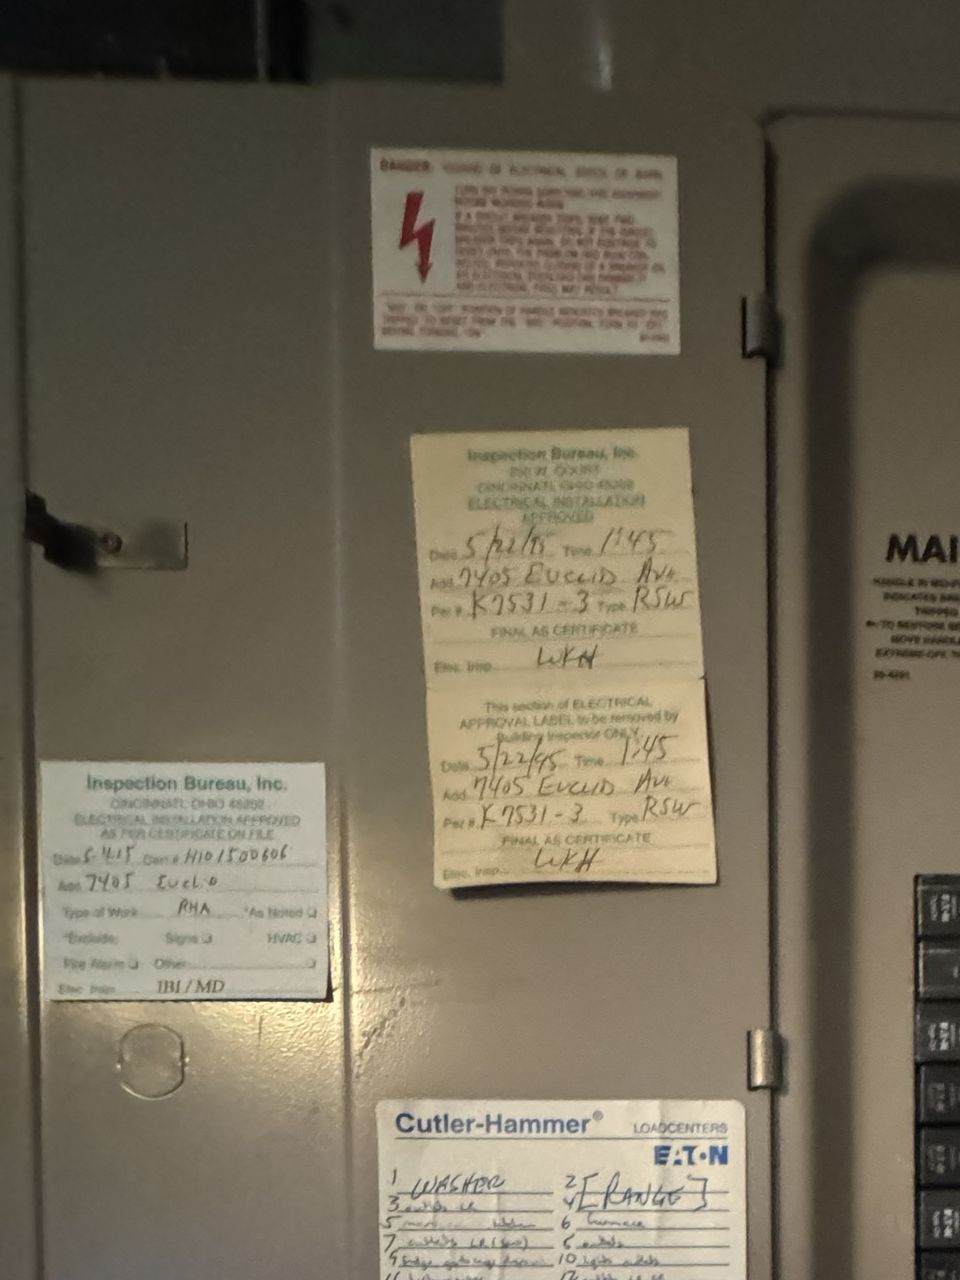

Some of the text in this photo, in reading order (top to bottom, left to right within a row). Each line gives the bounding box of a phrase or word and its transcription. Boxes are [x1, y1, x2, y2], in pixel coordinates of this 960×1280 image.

[467, 447, 546, 462] Inspection
[467, 495, 646, 511] ELECTRICAL INSTALLATION
[522, 512, 594, 524] APPROVED
[491, 622, 638, 638] FINAL AS CERTIFICATE
[573, 697, 653, 710] ELECTRICAL
[460, 715, 528, 731] APPROVAL
[533, 713, 575, 727] LABEL
[591, 713, 607, 725] be
[87, 773, 287, 794] Inspection Bureau, Inc.
[234, 814, 300, 826] APPROVED
[502, 831, 652, 847] FINAL AS CERTIFICATE
[633, 1121, 729, 1135] LOADCENTERS
[653, 1145, 729, 1165] EATON
[411, 1173, 505, 1200] WASHER
[565, 1174, 577, 1189] 2
[388, 1195, 400, 1213] 3
[561, 1216, 572, 1230] 6
[384, 1234, 397, 1253] 7
[558, 1253, 577, 1266] 10
